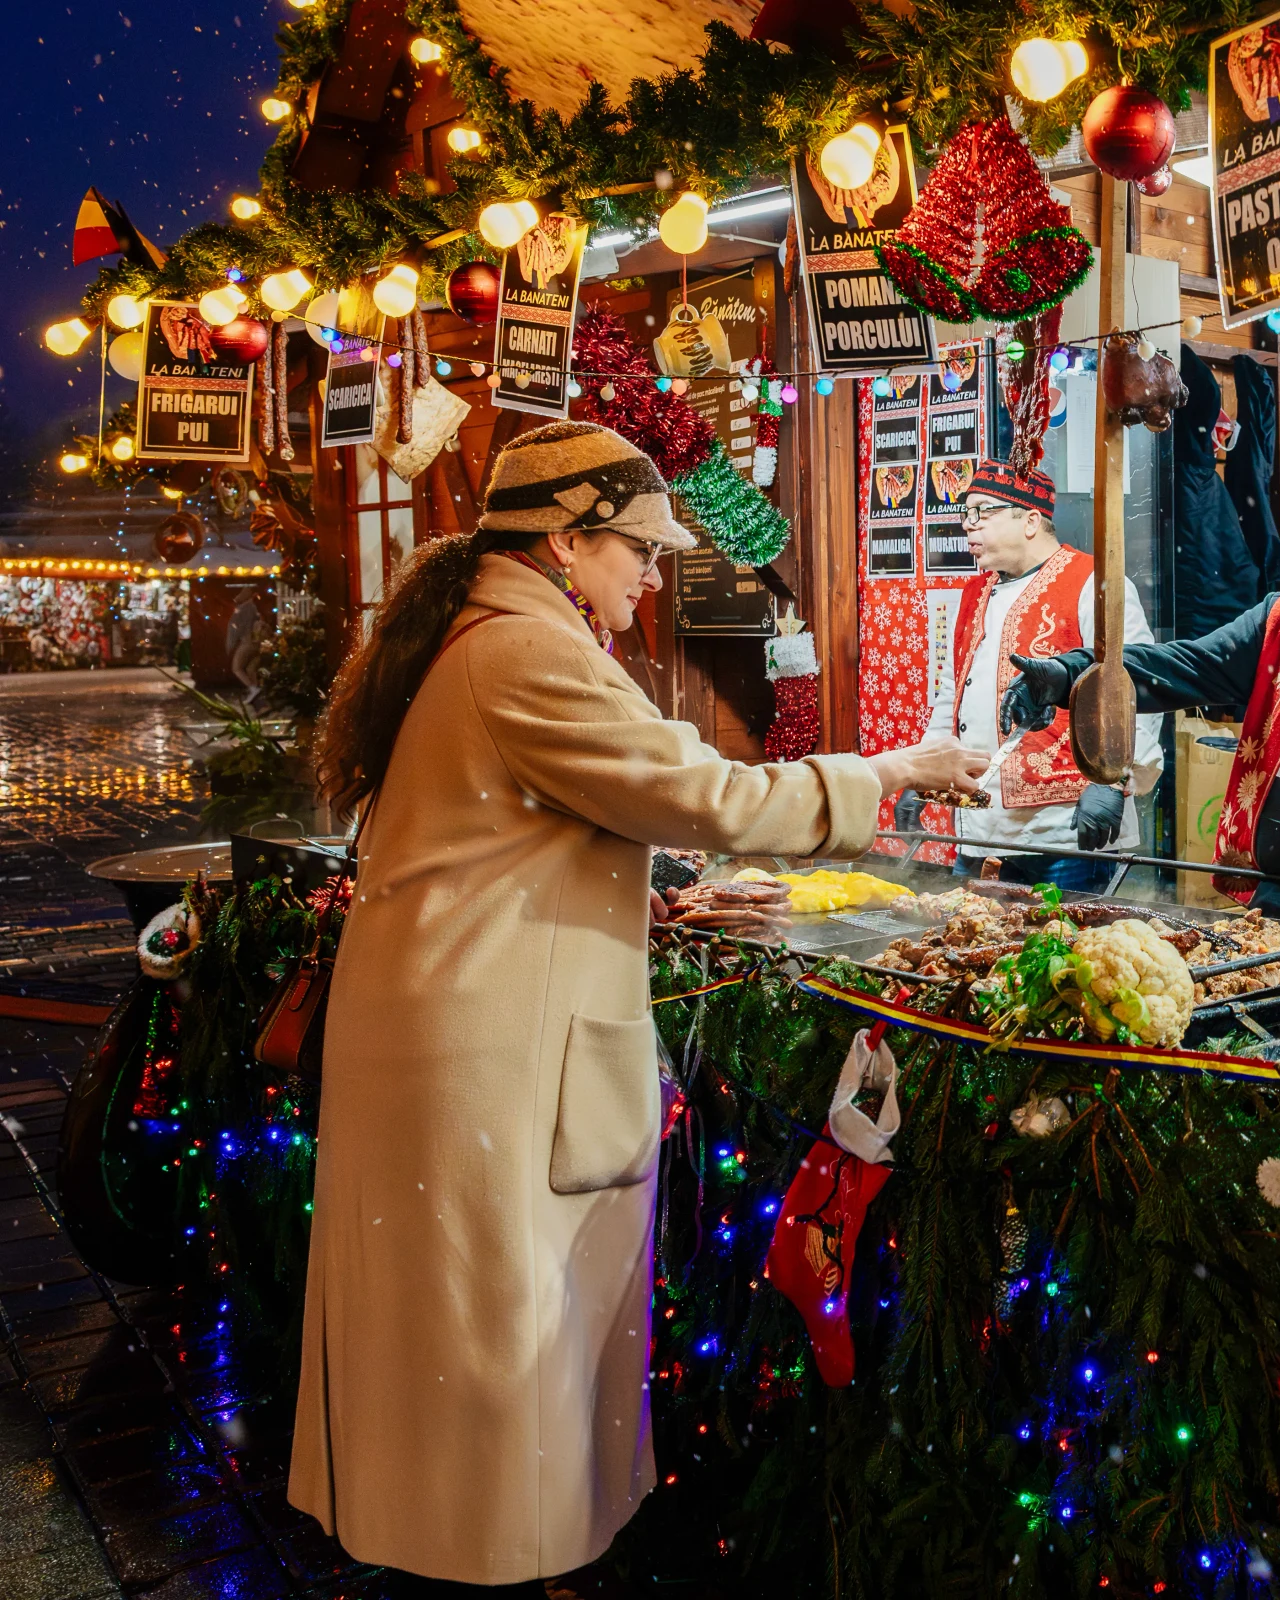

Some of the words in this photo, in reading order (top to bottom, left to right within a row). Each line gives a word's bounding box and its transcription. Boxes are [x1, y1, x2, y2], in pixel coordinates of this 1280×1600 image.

[1223, 142, 1245, 167] LA
[811, 236, 829, 251] LA
[833, 229, 900, 250] BANATE
[506, 288, 518, 302] LA
[520, 290, 570, 308] BANATENI
[508, 325, 557, 357] CARNATI
[825, 317, 921, 351] PORCULUI
[150, 363, 168, 376] LA
[171, 364, 243, 379] BANTENI
[152, 392, 239, 416] FRIGARUI
[328, 382, 372, 411] SCARICICA
[876, 402, 886, 411] LA
[887, 398, 918, 410] BANATENI
[932, 395, 941, 405] LA
[942, 390, 977, 403] BANATENI
[177, 421, 209, 442] PUI
[932, 412, 975, 433] FRIGARUI
[875, 430, 917, 449] SCARICICA
[944, 435, 962, 453] PUI
[871, 509, 881, 519] LA
[881, 508, 914, 518] BANATENI
[927, 505, 937, 514] LA
[938, 503, 968, 513] BANATE
[872, 538, 911, 555] MAMALIGA
